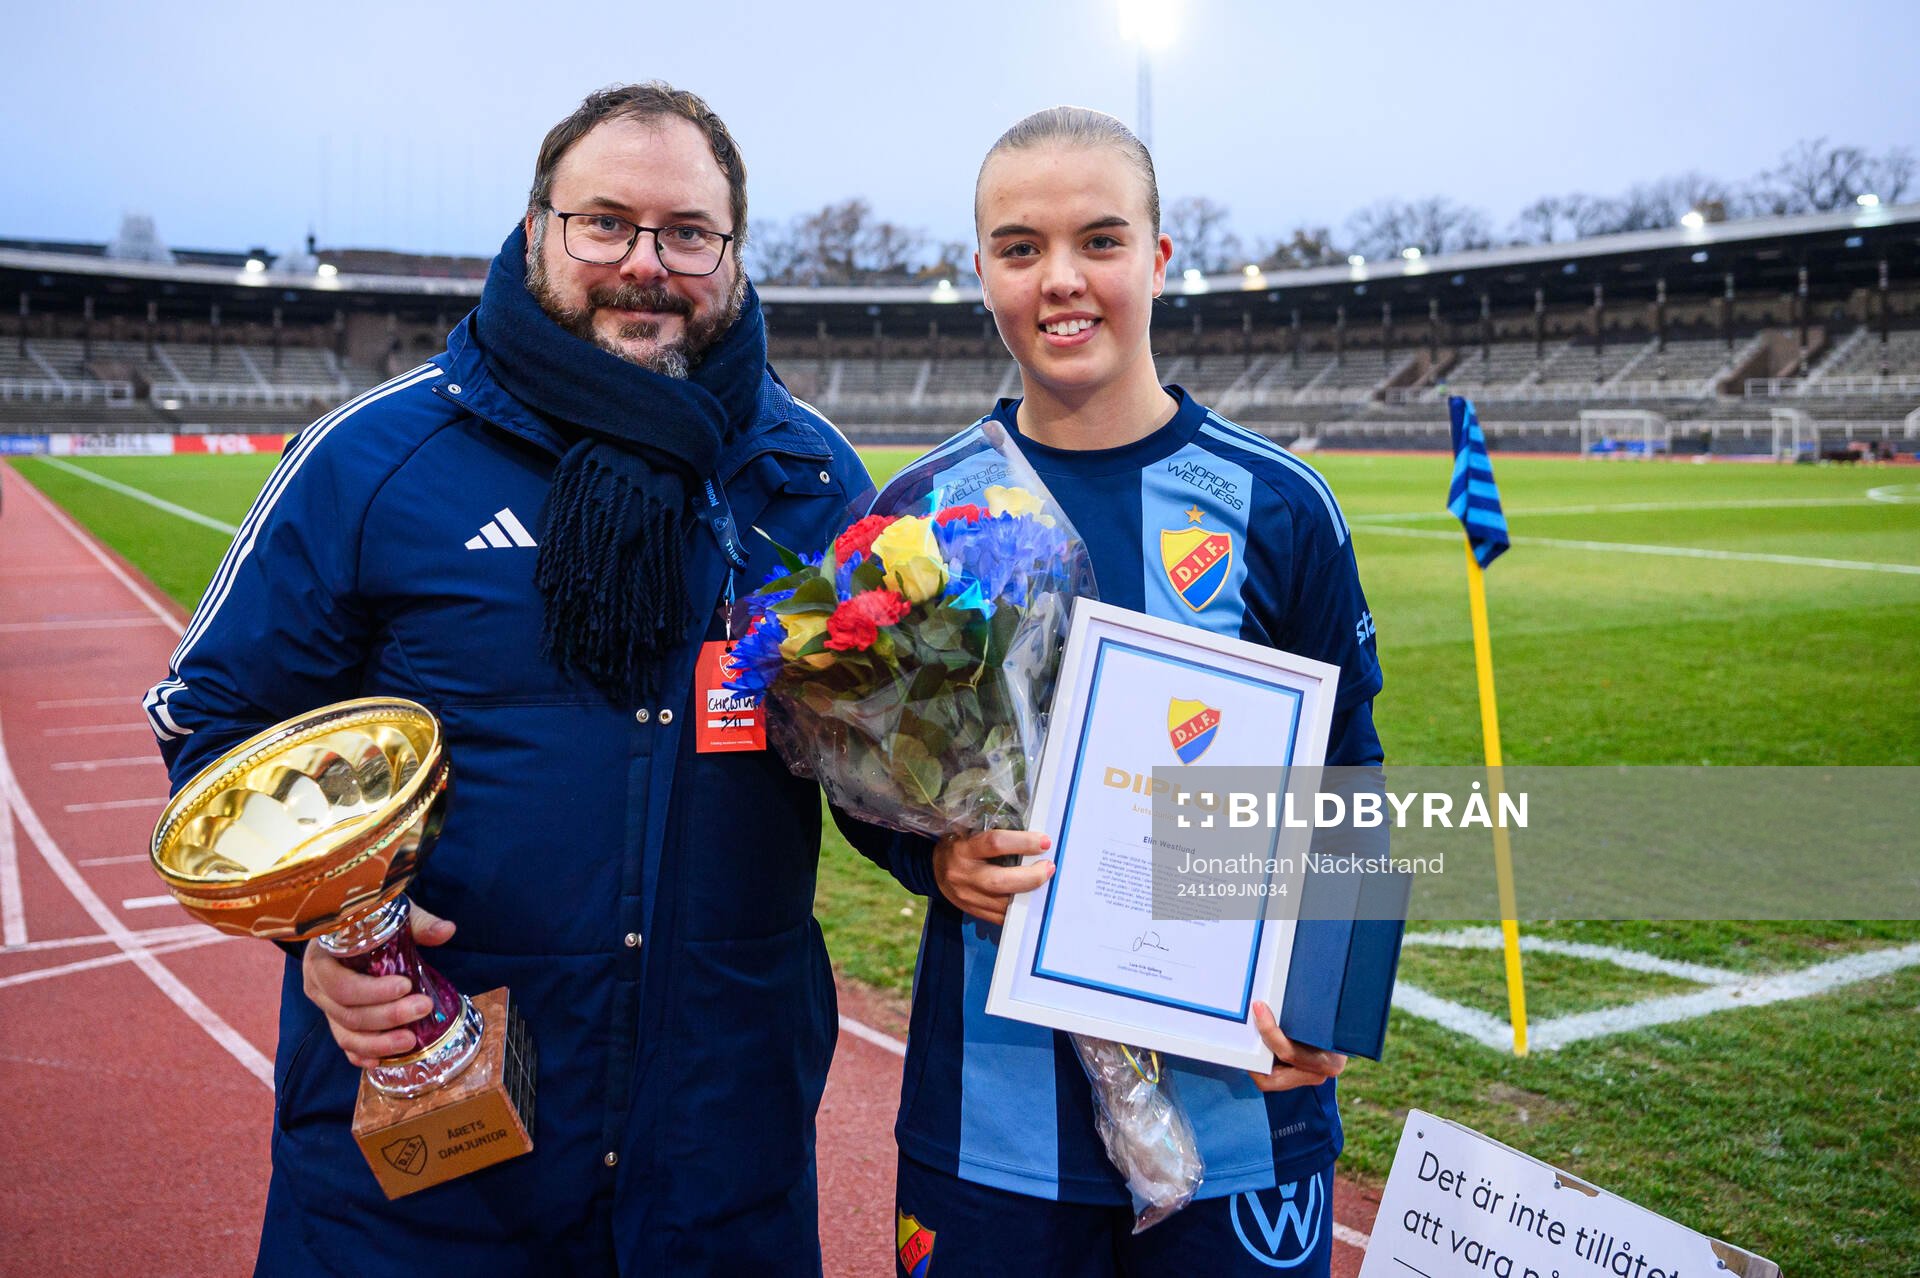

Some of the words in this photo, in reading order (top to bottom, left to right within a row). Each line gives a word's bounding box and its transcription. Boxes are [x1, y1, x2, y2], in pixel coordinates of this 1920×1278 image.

[946, 463, 1000, 492] NORDIC
[1167, 462, 1244, 511] WELLNESS
[1184, 461, 1238, 494] NORDIC
[1143, 836, 1157, 845] Elin
[1160, 839, 1196, 855] Westlund
[447, 1119, 485, 1139] ÅRETS
[1417, 1150, 1467, 1198] Det
[1472, 1177, 1504, 1214] är
[1508, 1193, 1566, 1245] inte
[1575, 1227, 1679, 1278] tillåt
[1403, 1209, 1444, 1245] att
[1451, 1229, 1514, 1278] vara
